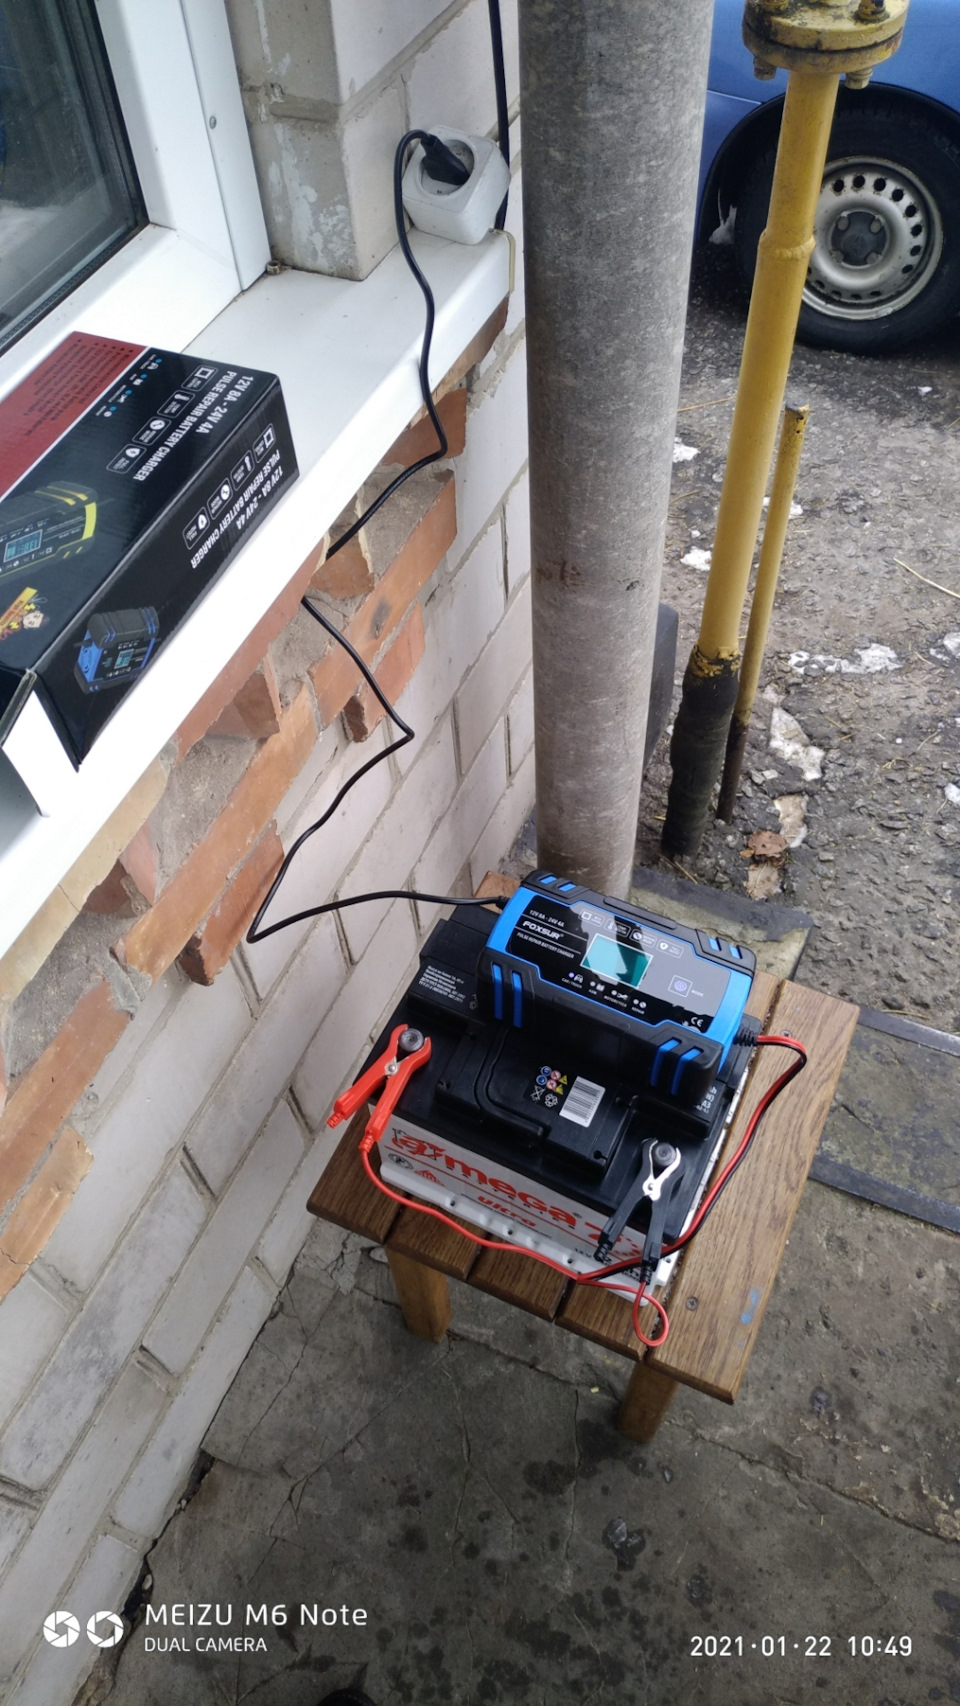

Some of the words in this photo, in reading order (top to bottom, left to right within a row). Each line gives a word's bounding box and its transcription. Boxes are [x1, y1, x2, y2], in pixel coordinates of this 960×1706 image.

[211, 370, 237, 393] PULSE
[234, 376, 254, 392] 12V
[190, 391, 220, 417] REPAIR
[223, 389, 242, 401] 8A
[207, 405, 228, 423] 24V
[163, 415, 198, 448] BATTERY
[195, 421, 213, 433] 4A
[132, 446, 170, 481] CHARGER
[262, 449, 280, 478] PULSE
[243, 470, 264, 502] REPAIR
[271, 465, 283, 487] 12V
[219, 496, 244, 534] BATTERY
[246, 496, 259, 520] 24V
[236, 514, 246, 530] 4A
[190, 528, 220, 569] CHARGER
[522, 920, 560, 940] FOXSUR
